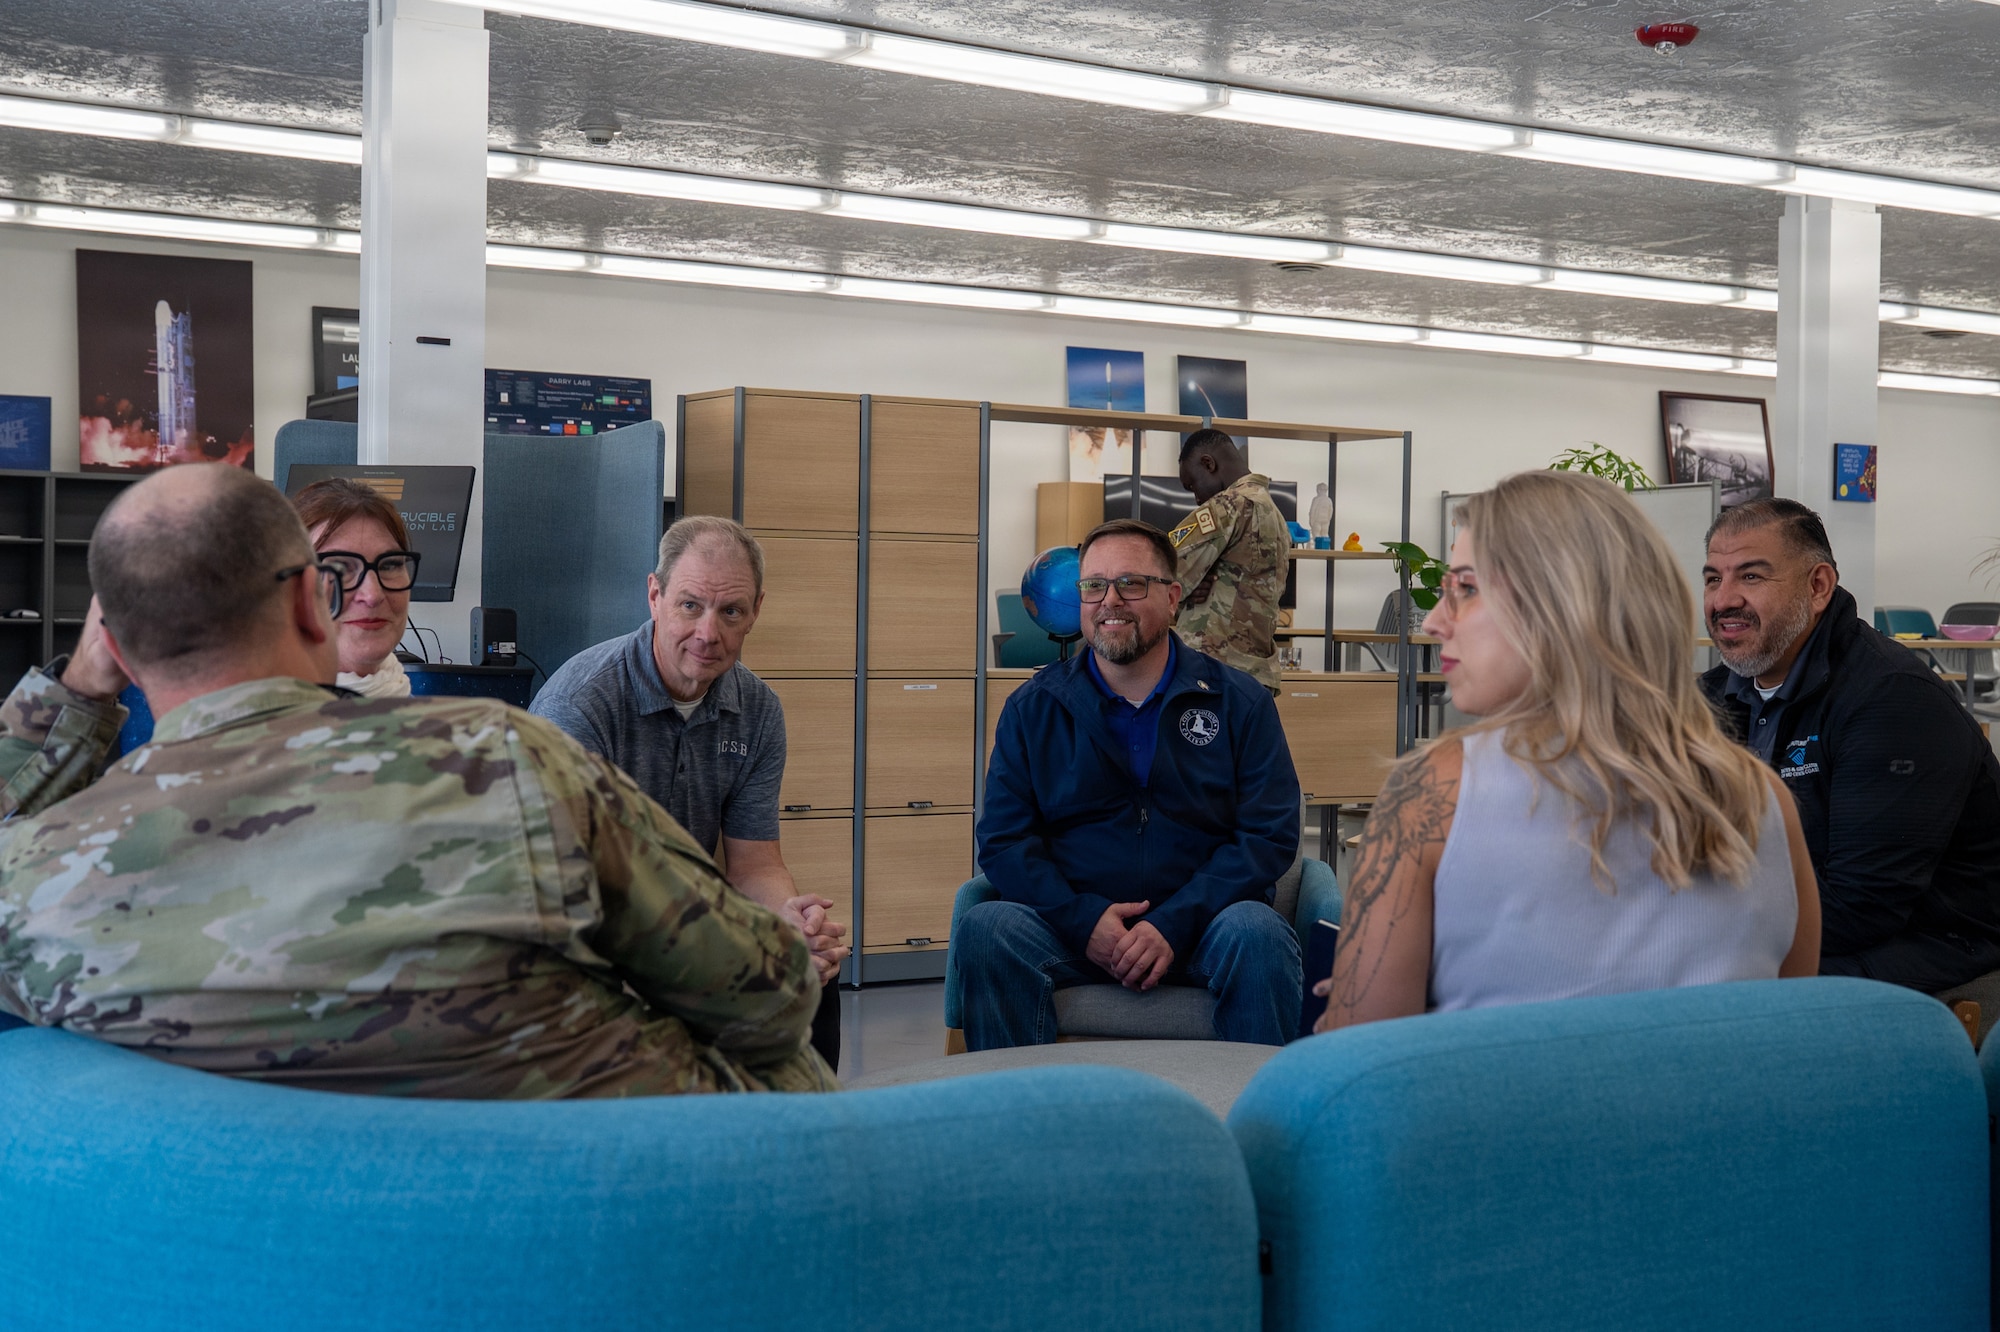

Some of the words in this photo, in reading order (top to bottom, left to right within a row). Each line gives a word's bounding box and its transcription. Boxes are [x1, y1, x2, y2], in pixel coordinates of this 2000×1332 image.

[548, 377, 571, 385] PARRY
[573, 379, 592, 387] LABS
[398, 512, 456, 522] RUCIBLE
[1199, 512, 1213, 529] GT
[432, 523, 455, 531] LAB
